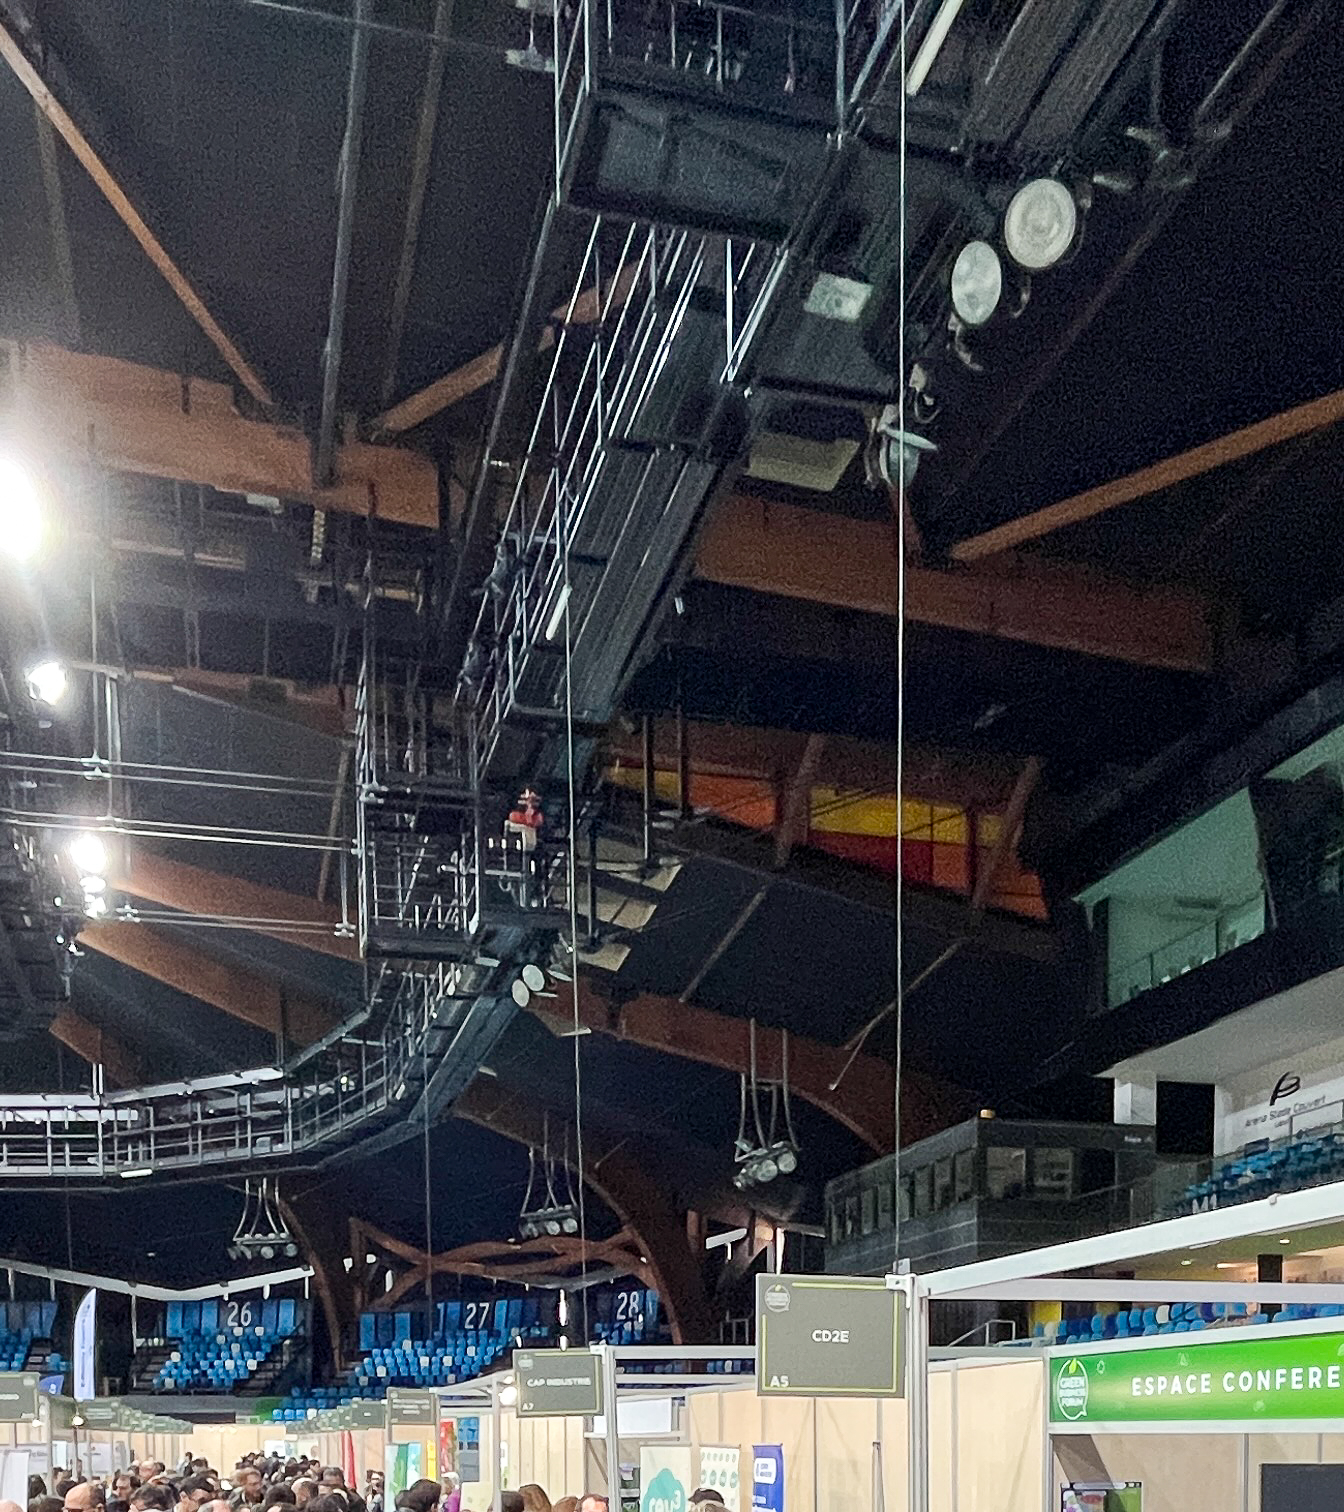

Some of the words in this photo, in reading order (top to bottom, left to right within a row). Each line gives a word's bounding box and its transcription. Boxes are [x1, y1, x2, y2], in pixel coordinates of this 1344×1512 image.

[226, 1301, 253, 1327] 26
[464, 1302, 490, 1329] 27
[616, 1291, 639, 1321] 28
[811, 1329, 850, 1343] CD2E
[1131, 1373, 1212, 1396] ESPACE
